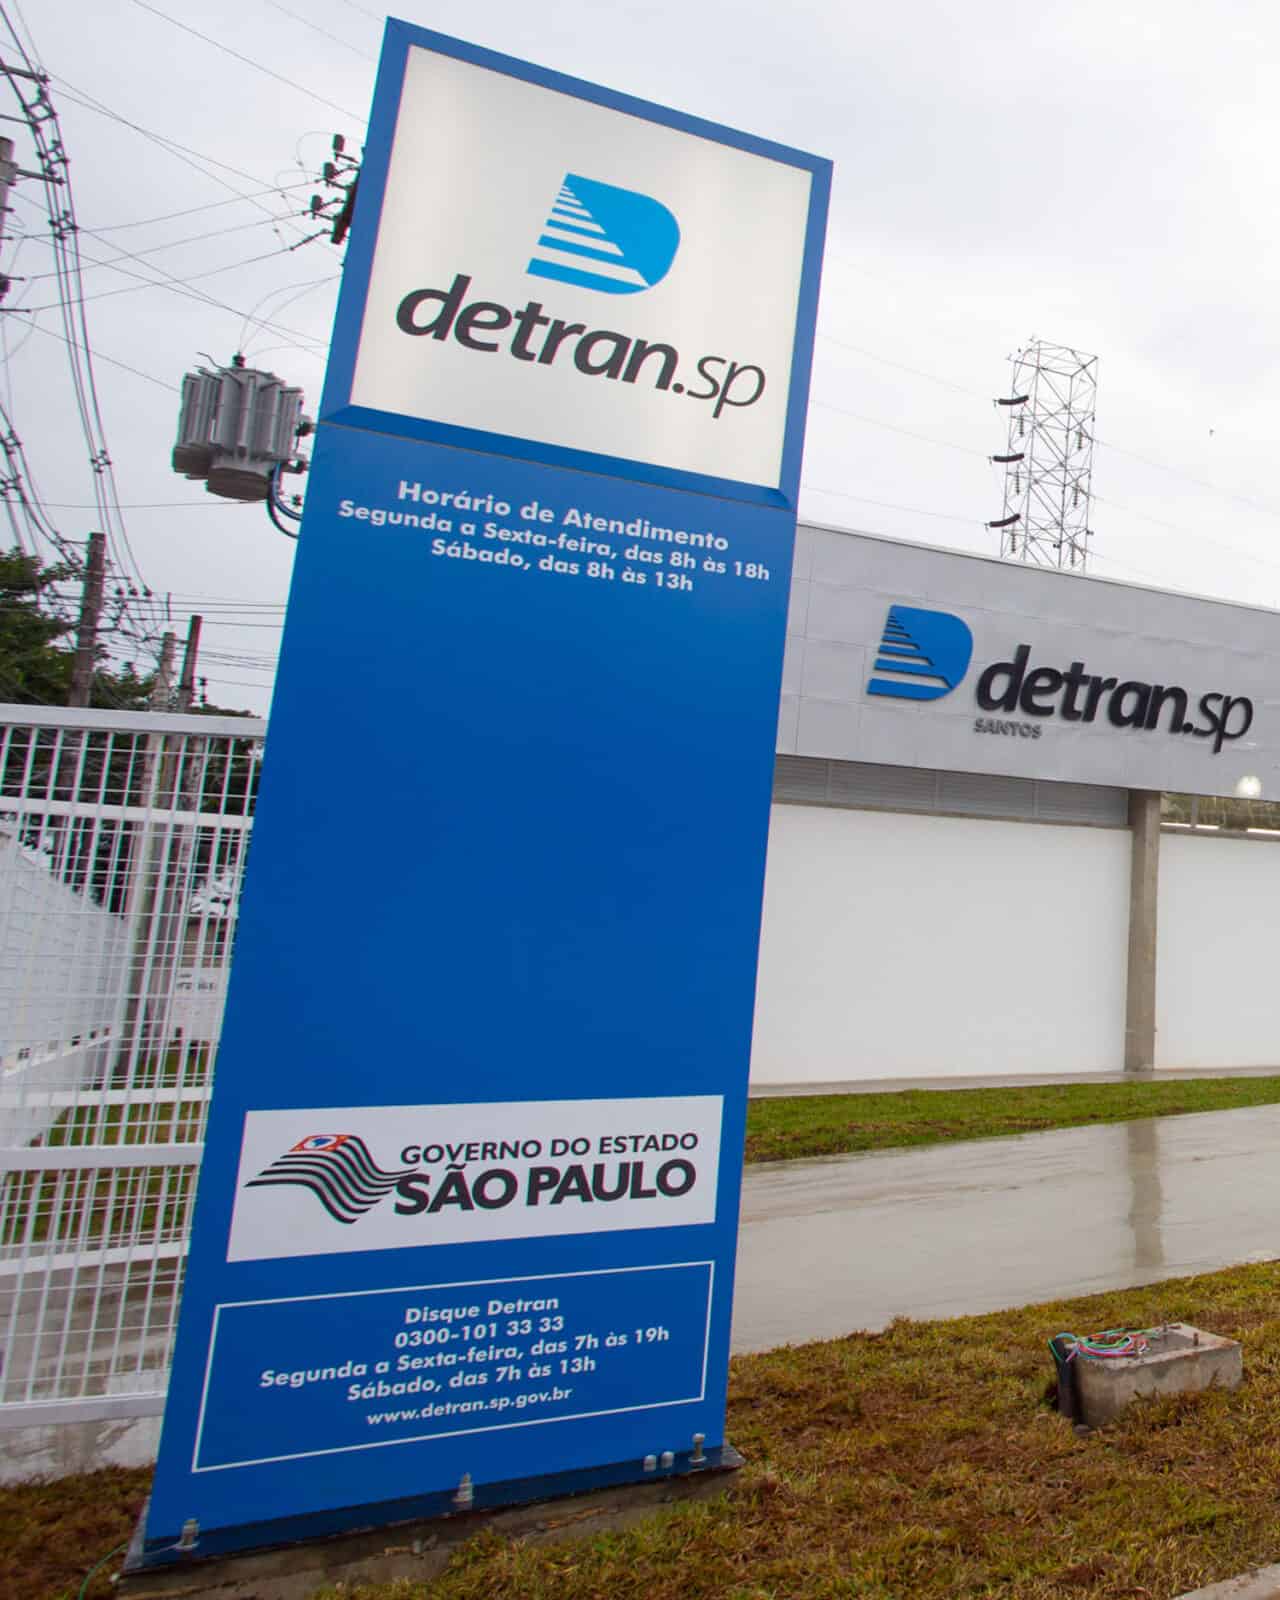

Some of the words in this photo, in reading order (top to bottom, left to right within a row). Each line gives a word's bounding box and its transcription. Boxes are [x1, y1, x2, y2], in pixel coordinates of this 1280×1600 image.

[395, 274, 766, 418] detran.sp
[338, 499, 452, 533] Segunda
[460, 522, 476, 536] a
[483, 522, 617, 560] Sexta-feira,
[624, 544, 663, 565] das
[669, 551, 696, 570] 8h
[702, 556, 726, 574] às
[733, 560, 770, 581] 18h
[397, 480, 511, 516] Horário
[520, 501, 555, 523] de
[562, 508, 729, 551] Atendimento
[431, 538, 531, 571] Sábado,
[538, 554, 580, 575] das
[586, 561, 615, 580] 8h
[621, 566, 647, 584] às
[654, 571, 693, 591] 13h
[975, 644, 1253, 754] detran.sp
[973, 717, 1042, 740] SANTOS
[400, 1139, 543, 1165] GOVERNO
[550, 1137, 591, 1157] DO
[599, 1132, 698, 1155] ESTADO
[394, 1163, 518, 1216] SÃO
[525, 1158, 697, 1207] PAULO
[394, 1322, 497, 1349] 0300-101
[506, 1319, 532, 1336] 33
[539, 1315, 564, 1333] 33
[404, 1305, 480, 1325] Disque
[487, 1298, 559, 1316] Detran
[259, 1360, 368, 1388] Segunda
[374, 1360, 389, 1374] a
[396, 1345, 524, 1372] Sexta-feira,
[531, 1339, 568, 1356] das
[574, 1333, 599, 1351] 7h
[605, 1331, 628, 1347] às
[635, 1325, 669, 1344] 19h
[347, 1376, 442, 1401] Sábado,
[449, 1370, 488, 1388] das
[495, 1365, 521, 1383] 7h
[528, 1362, 552, 1379] às
[560, 1356, 596, 1374] 13h
[366, 1387, 573, 1425] www.detran.sp.gov.br
